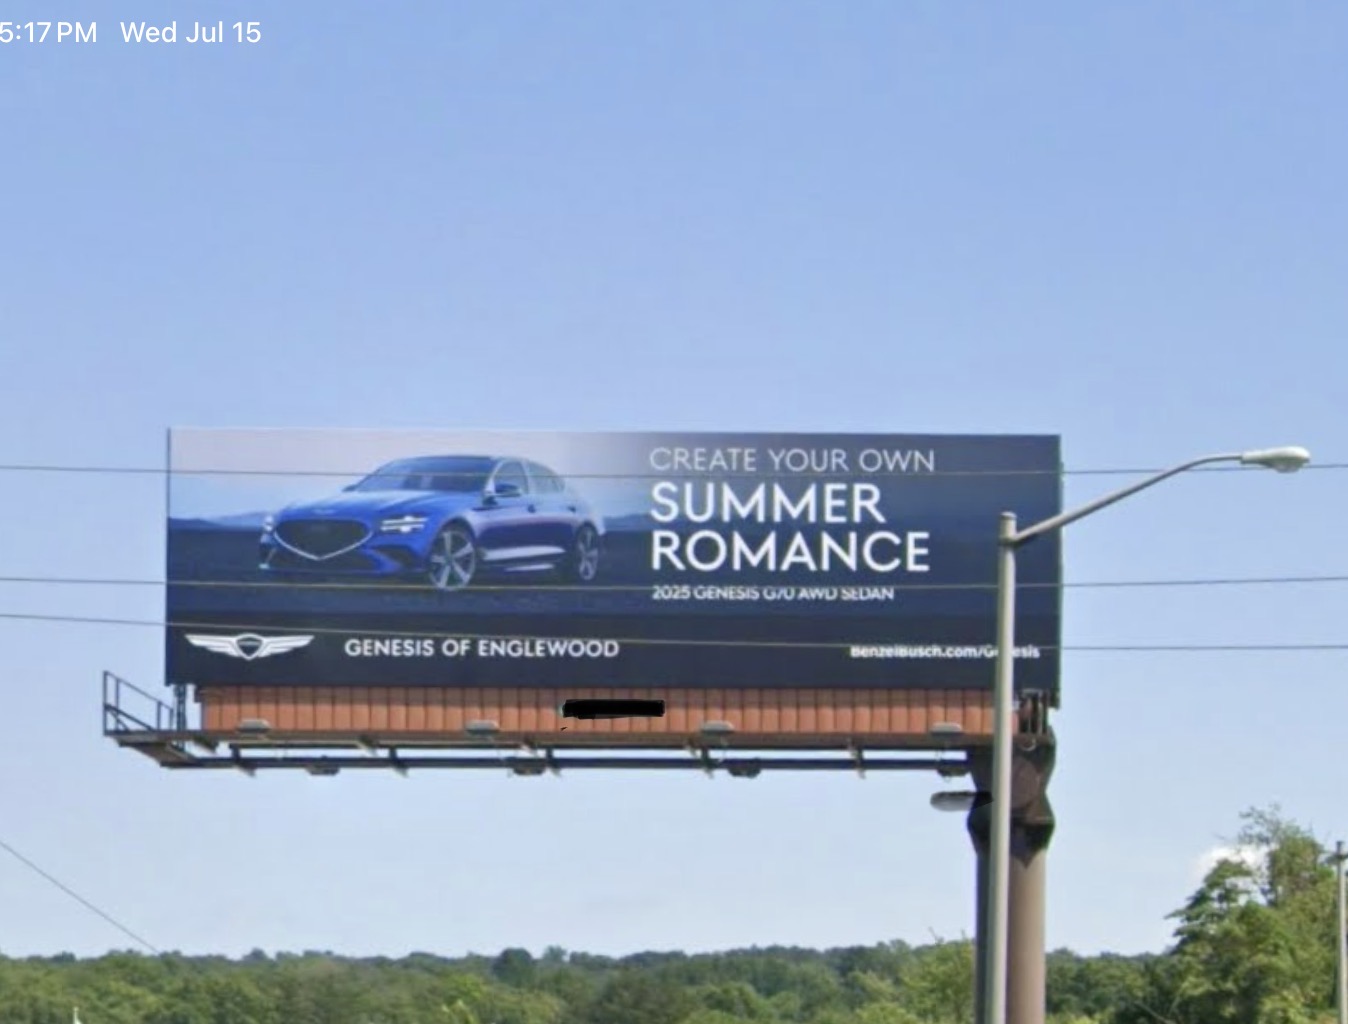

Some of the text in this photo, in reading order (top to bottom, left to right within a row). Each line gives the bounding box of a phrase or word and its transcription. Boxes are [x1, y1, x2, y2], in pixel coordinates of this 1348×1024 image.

[649, 447, 934, 472] CREATE YOUR OWN
[650, 481, 886, 523] SUMMER
[651, 530, 930, 572] ROMANCE
[652, 585, 691, 600] 2025
[693, 585, 760, 600] GENESIS
[798, 586, 838, 600] AWD
[840, 586, 895, 600] SEDAN
[344, 638, 620, 657] GENESIS OF ENGLEWOOD
